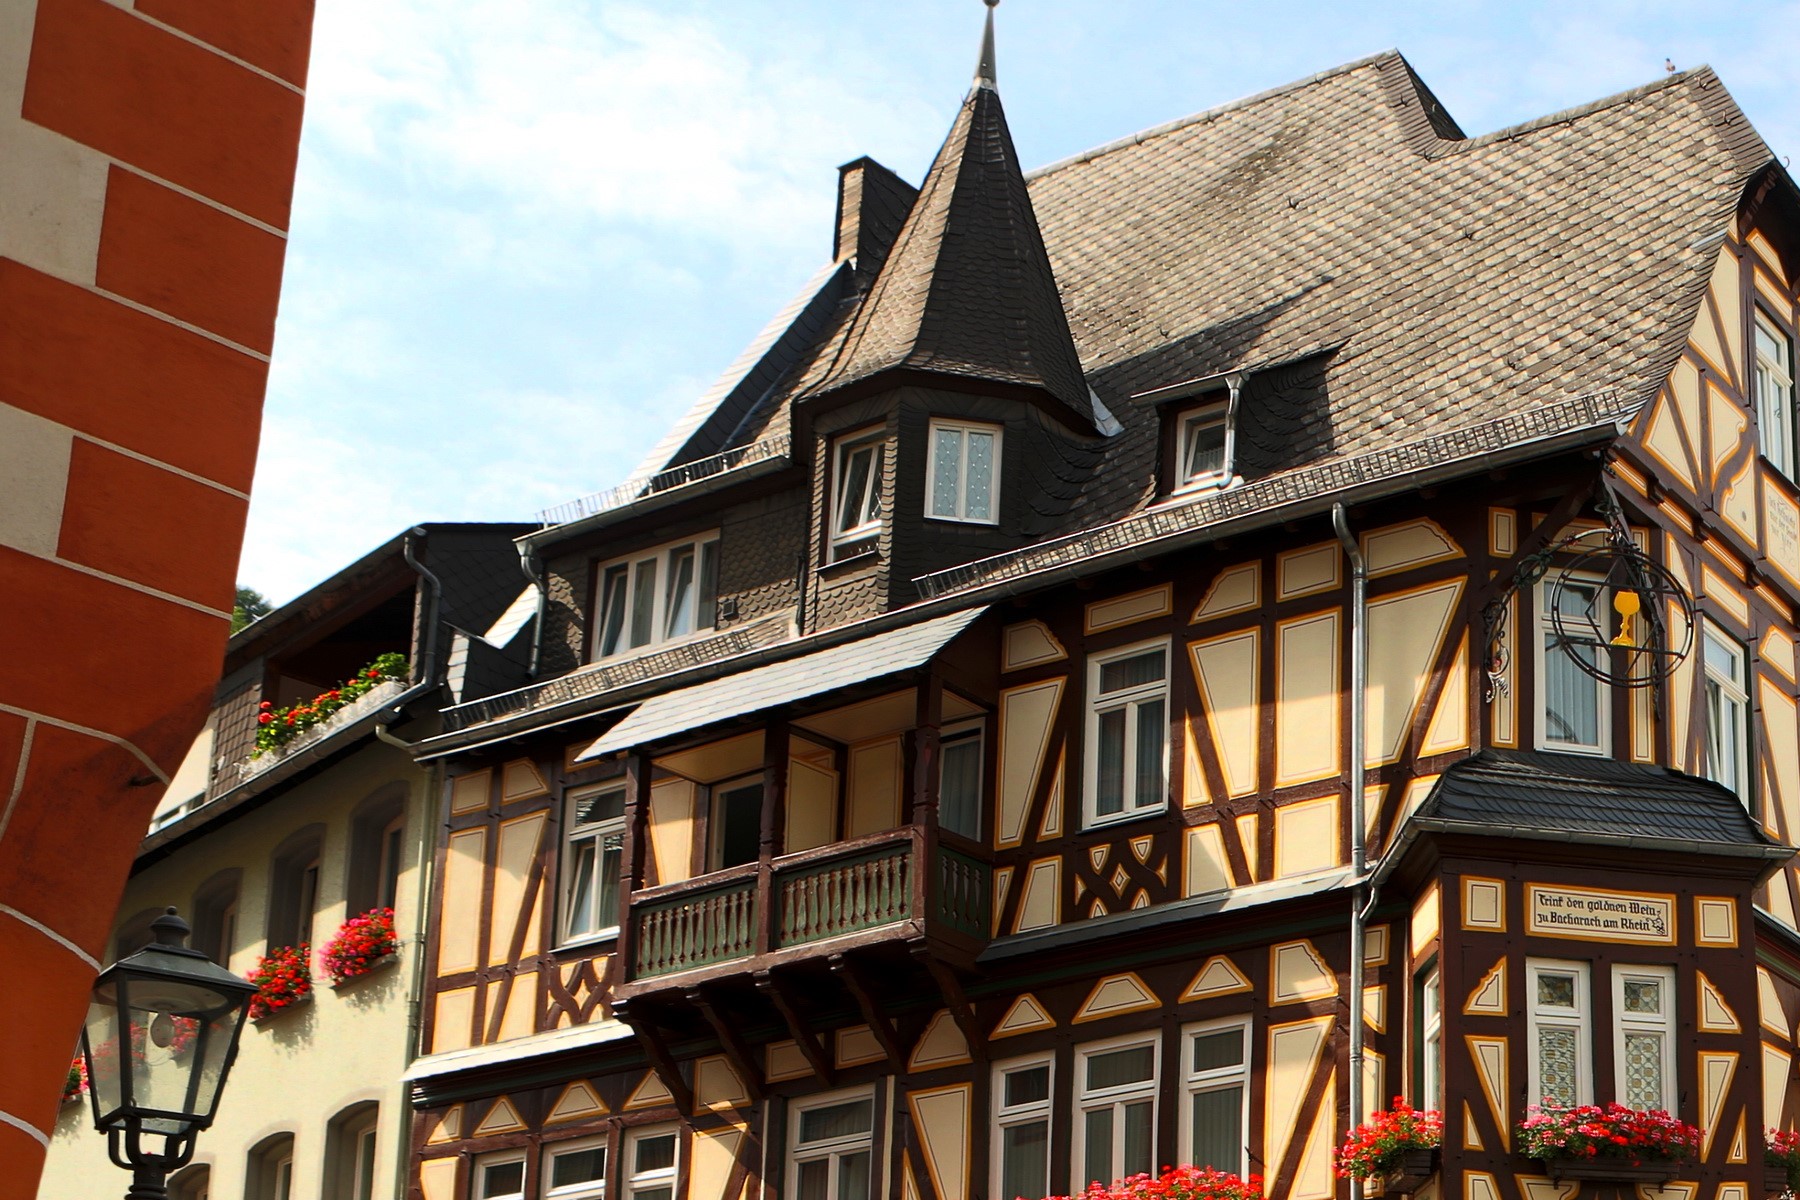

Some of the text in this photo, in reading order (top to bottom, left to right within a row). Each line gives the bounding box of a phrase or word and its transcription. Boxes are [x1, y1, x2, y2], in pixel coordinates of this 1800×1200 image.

[1567, 897, 1584, 909] den
[1587, 900, 1627, 913] goldnen
[1537, 912, 1650, 931] zu Bacharach am Rhein
